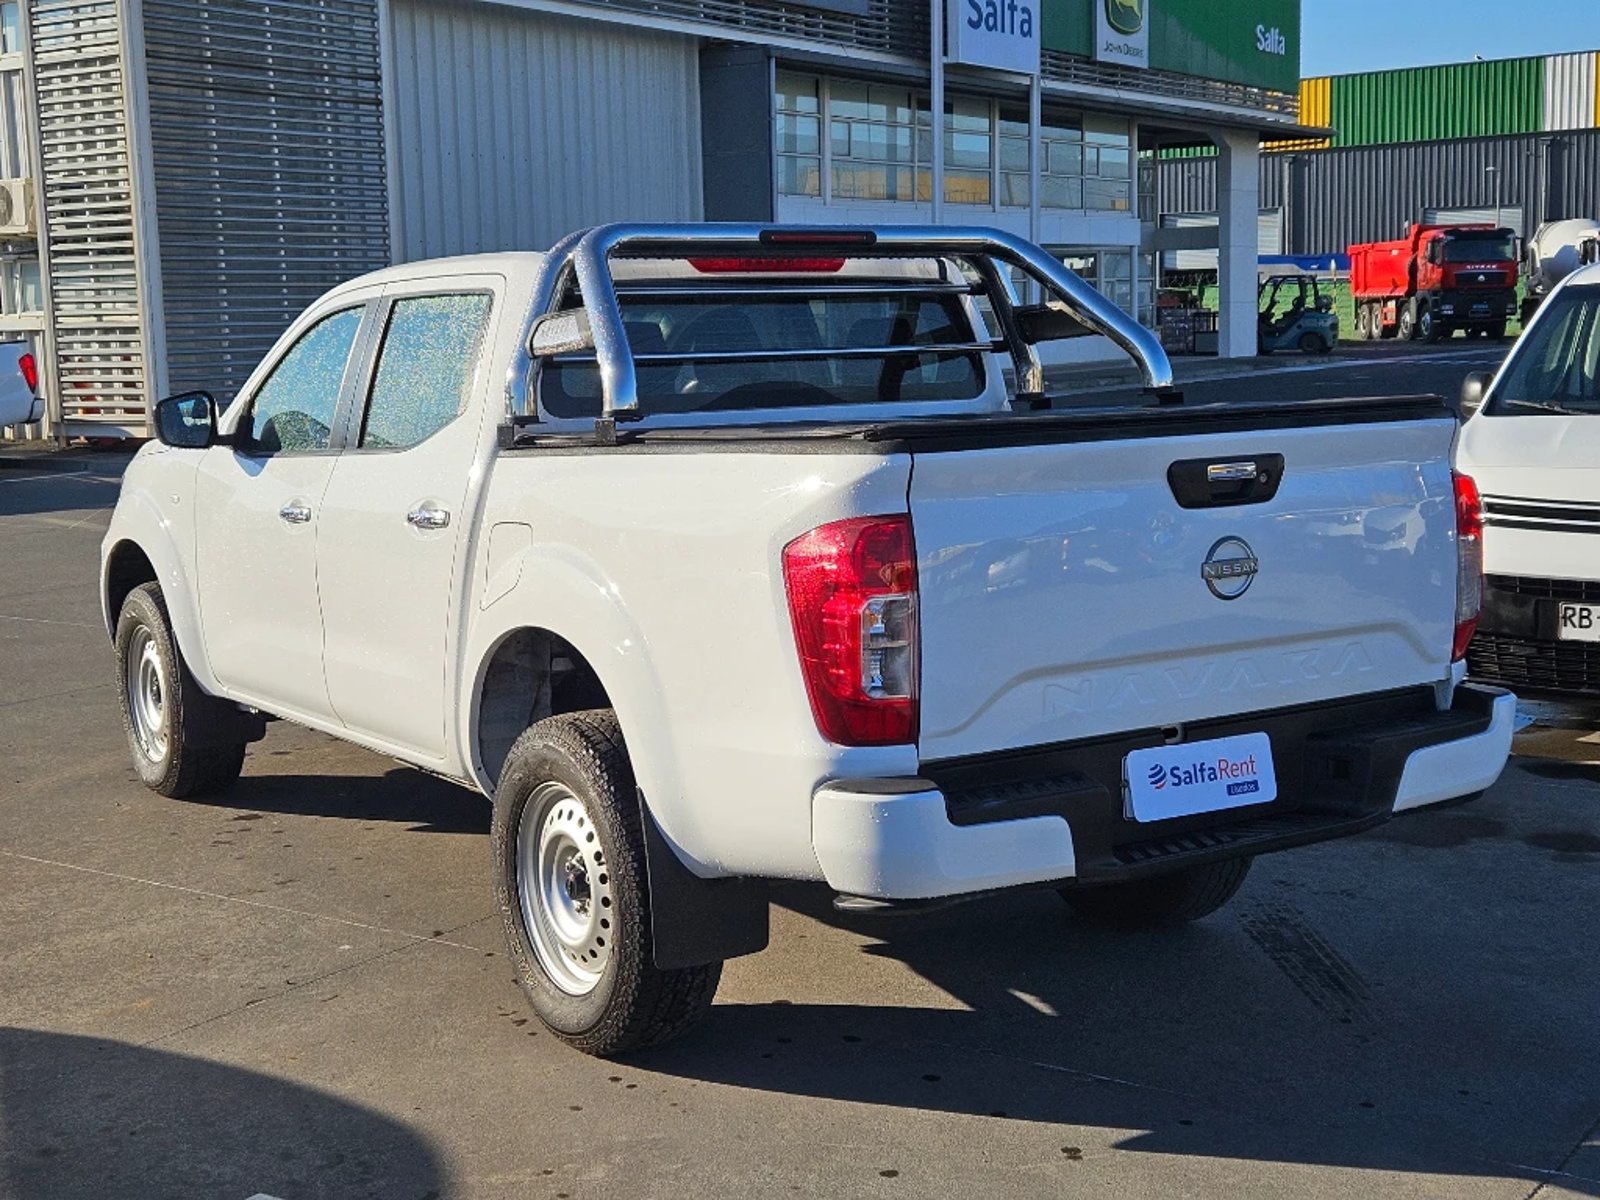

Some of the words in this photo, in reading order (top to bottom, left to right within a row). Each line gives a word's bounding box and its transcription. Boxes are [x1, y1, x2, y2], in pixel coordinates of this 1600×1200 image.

[967, 0, 1032, 38] Salfa
[1256, 24, 1285, 55] Salfa
[1205, 561, 1257, 575] NISSAN
[1042, 641, 1375, 718] NAVARA
[1169, 754, 1257, 787] SalfaRent
